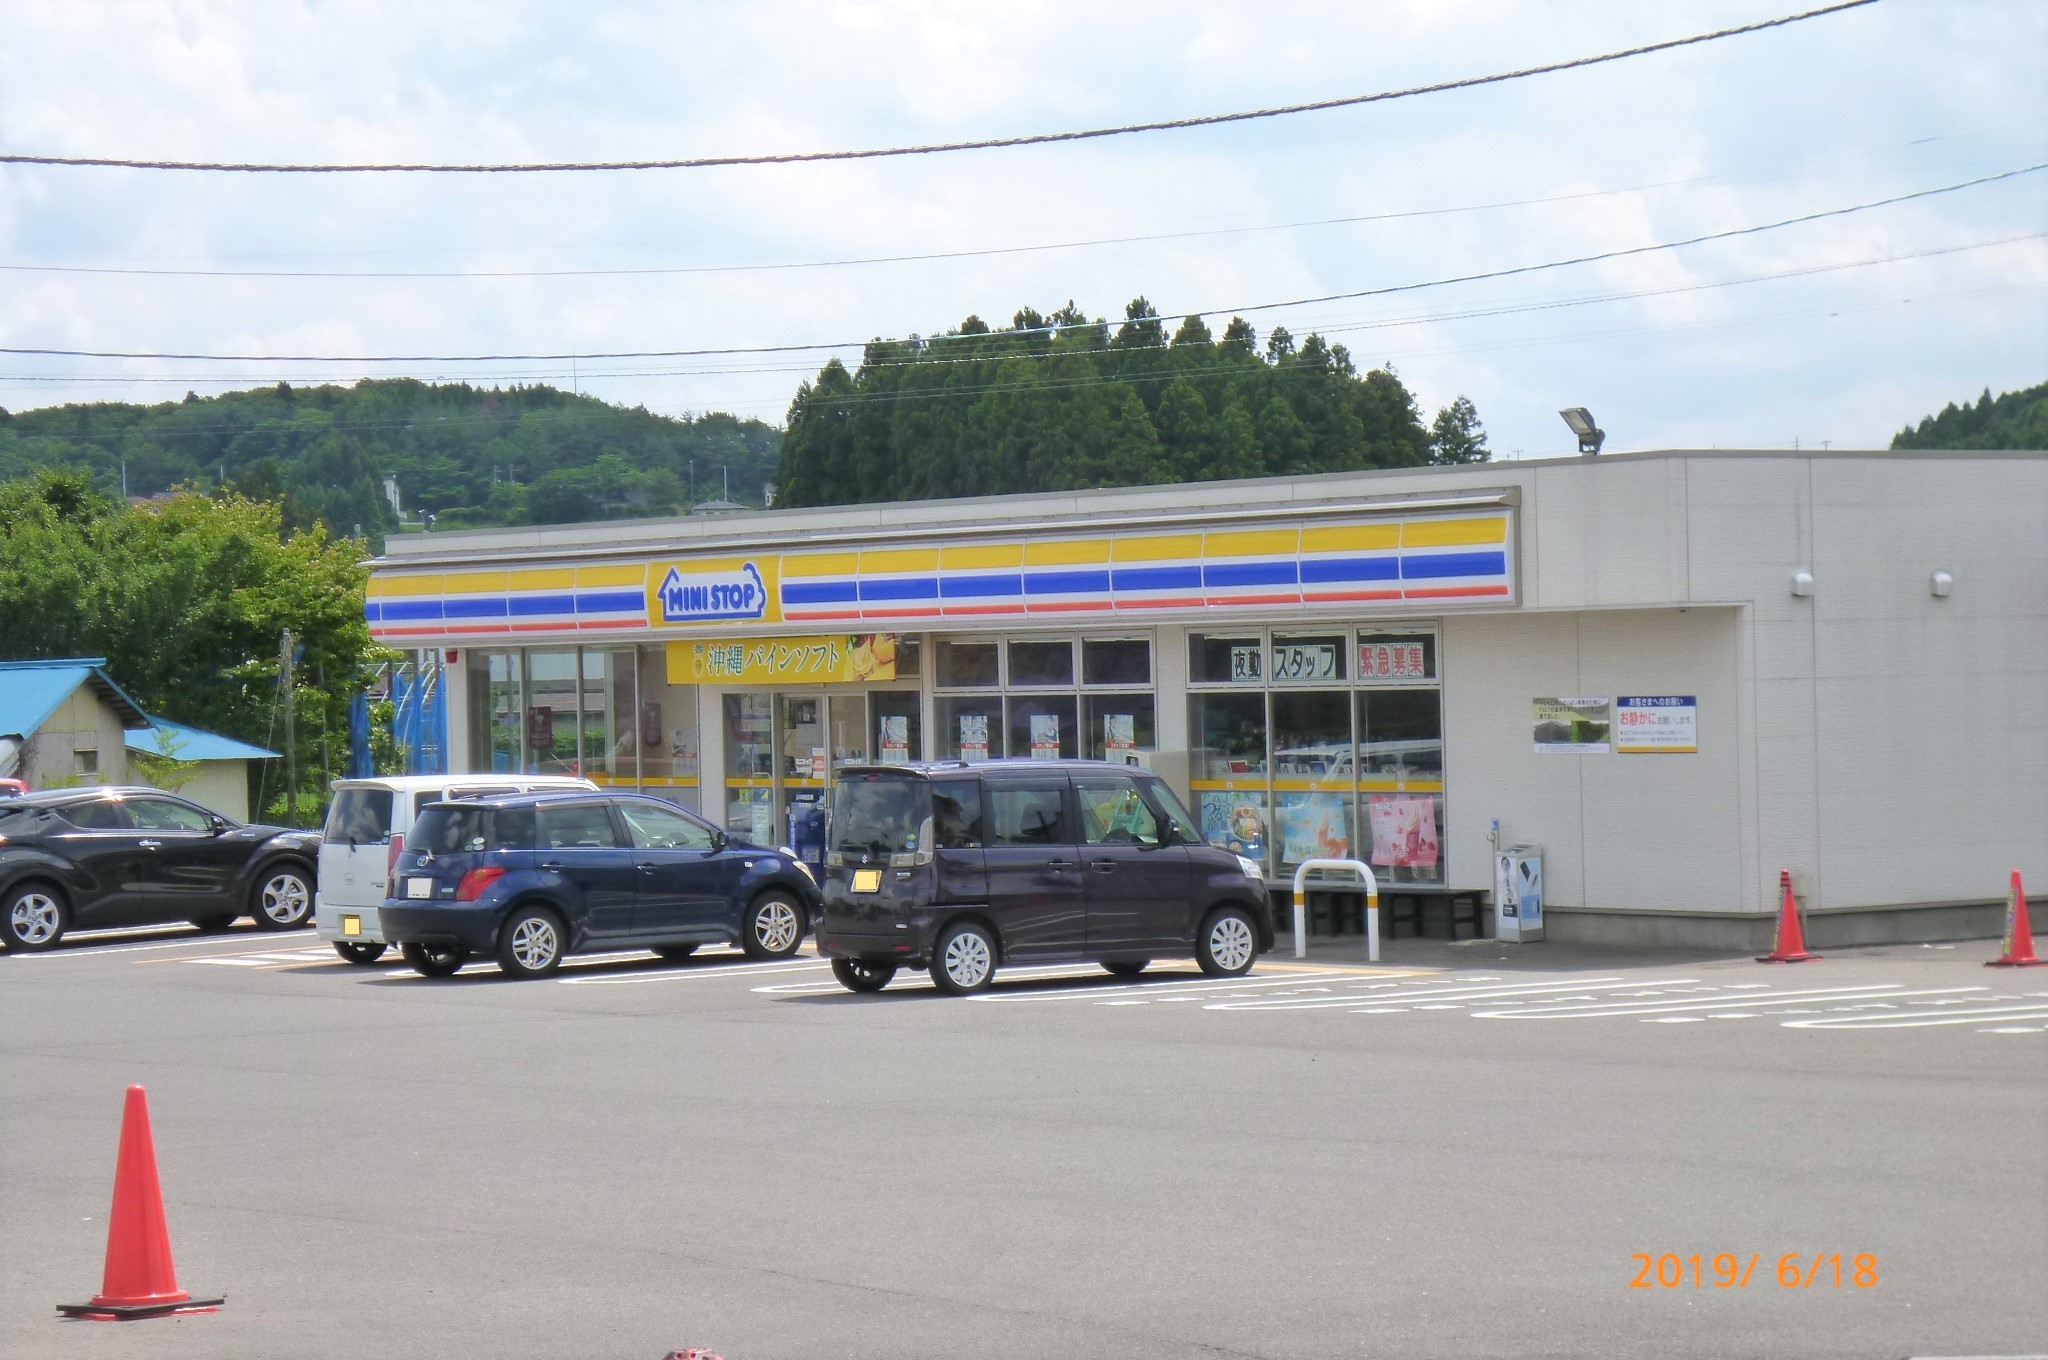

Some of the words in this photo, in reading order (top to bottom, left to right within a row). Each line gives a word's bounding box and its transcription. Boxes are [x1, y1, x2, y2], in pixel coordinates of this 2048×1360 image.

[668, 585, 708, 612] MINI
[710, 583, 755, 611] STOP
[708, 641, 839, 676] 沖縄パインソフト
[1233, 649, 1262, 677] 夜勤
[1274, 647, 1334, 677] スタッフ
[1359, 646, 1423, 676] 緊急募集
